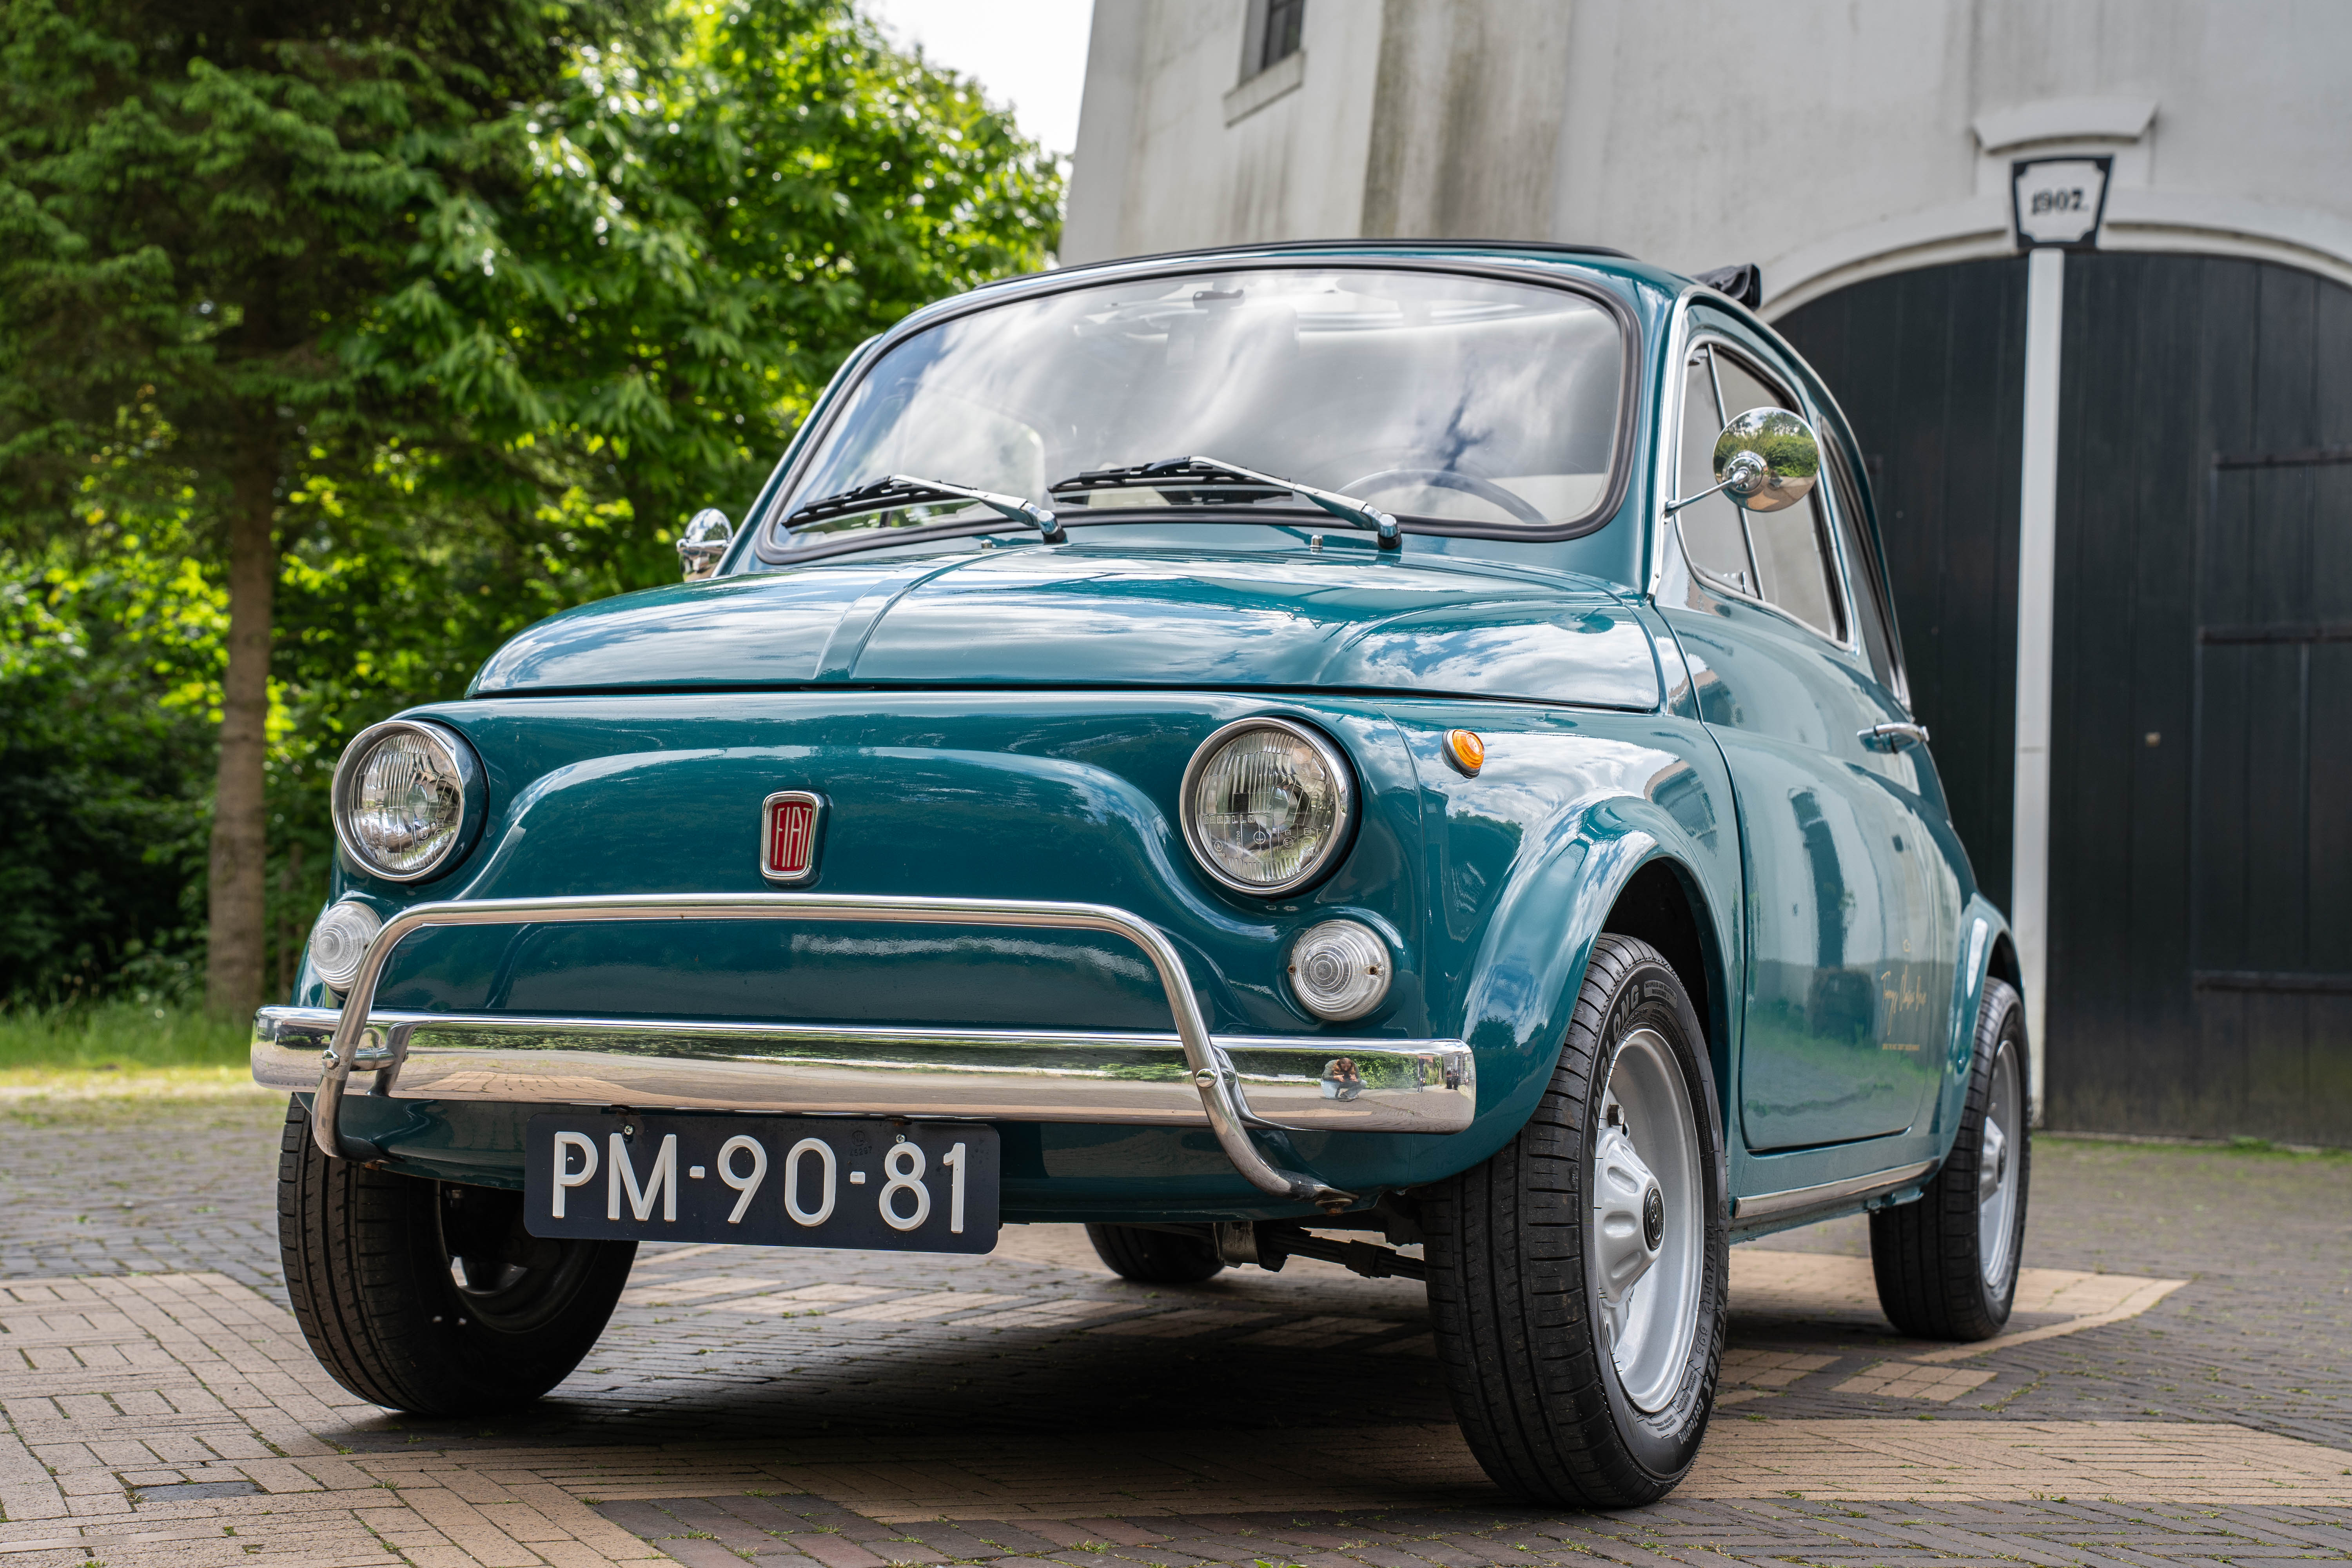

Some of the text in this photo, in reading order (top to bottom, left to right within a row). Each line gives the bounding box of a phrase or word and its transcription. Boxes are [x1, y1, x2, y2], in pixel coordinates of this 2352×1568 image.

[774, 807, 812, 867] FIAT
[1203, 815, 1255, 824] CARELLO
[553, 1131, 965, 1234] PM-90-81
[1696, 1324, 1708, 1356] 69S
